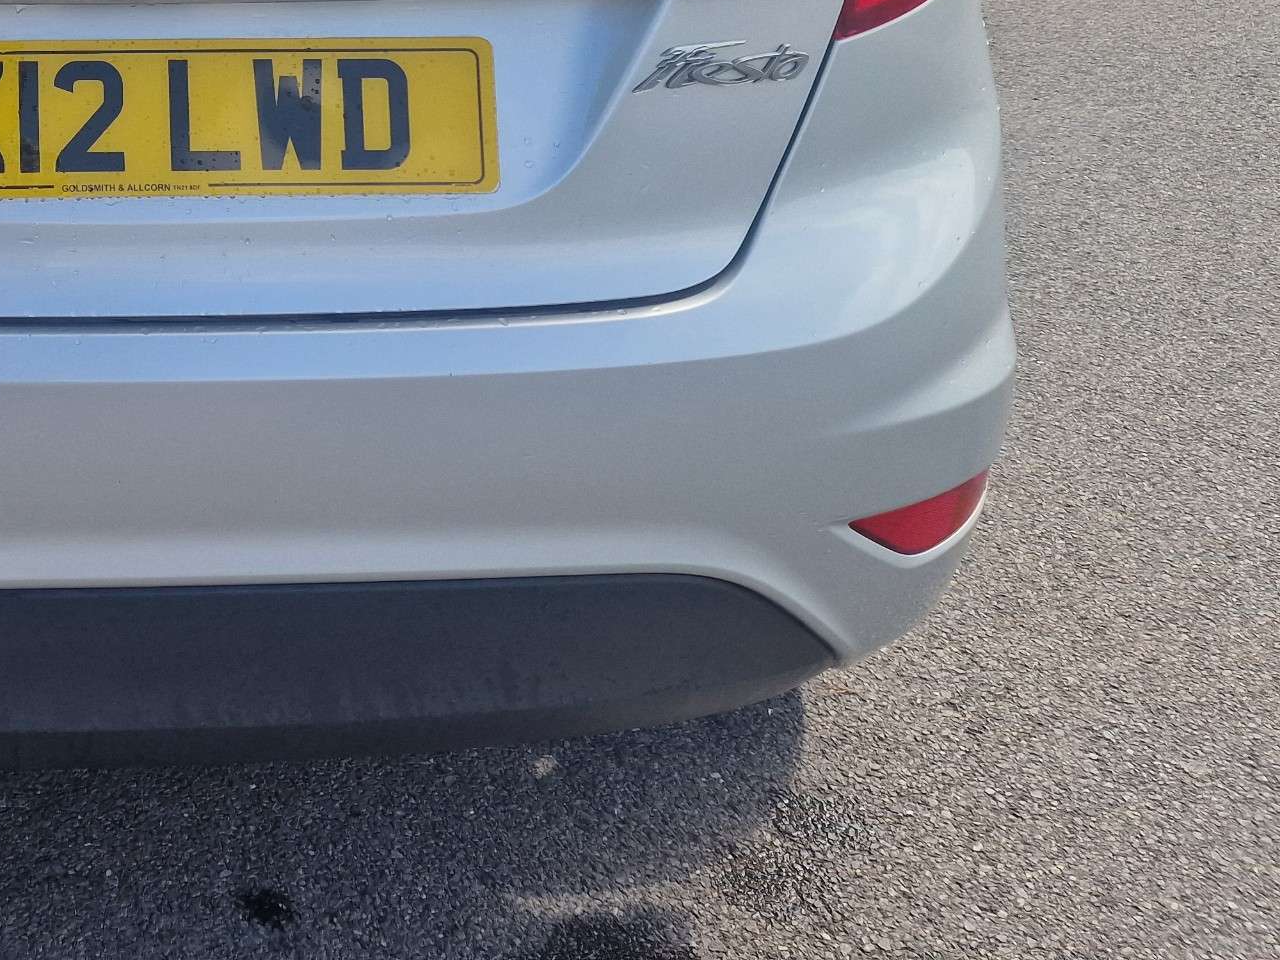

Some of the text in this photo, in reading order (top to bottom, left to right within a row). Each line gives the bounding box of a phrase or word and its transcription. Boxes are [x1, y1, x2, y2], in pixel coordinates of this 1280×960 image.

[166, 58, 412, 172] LWD
[61, 183, 116, 193] GOLDSMITH
[119, 183, 125, 192] &
[127, 182, 171, 192] ALLCORN
